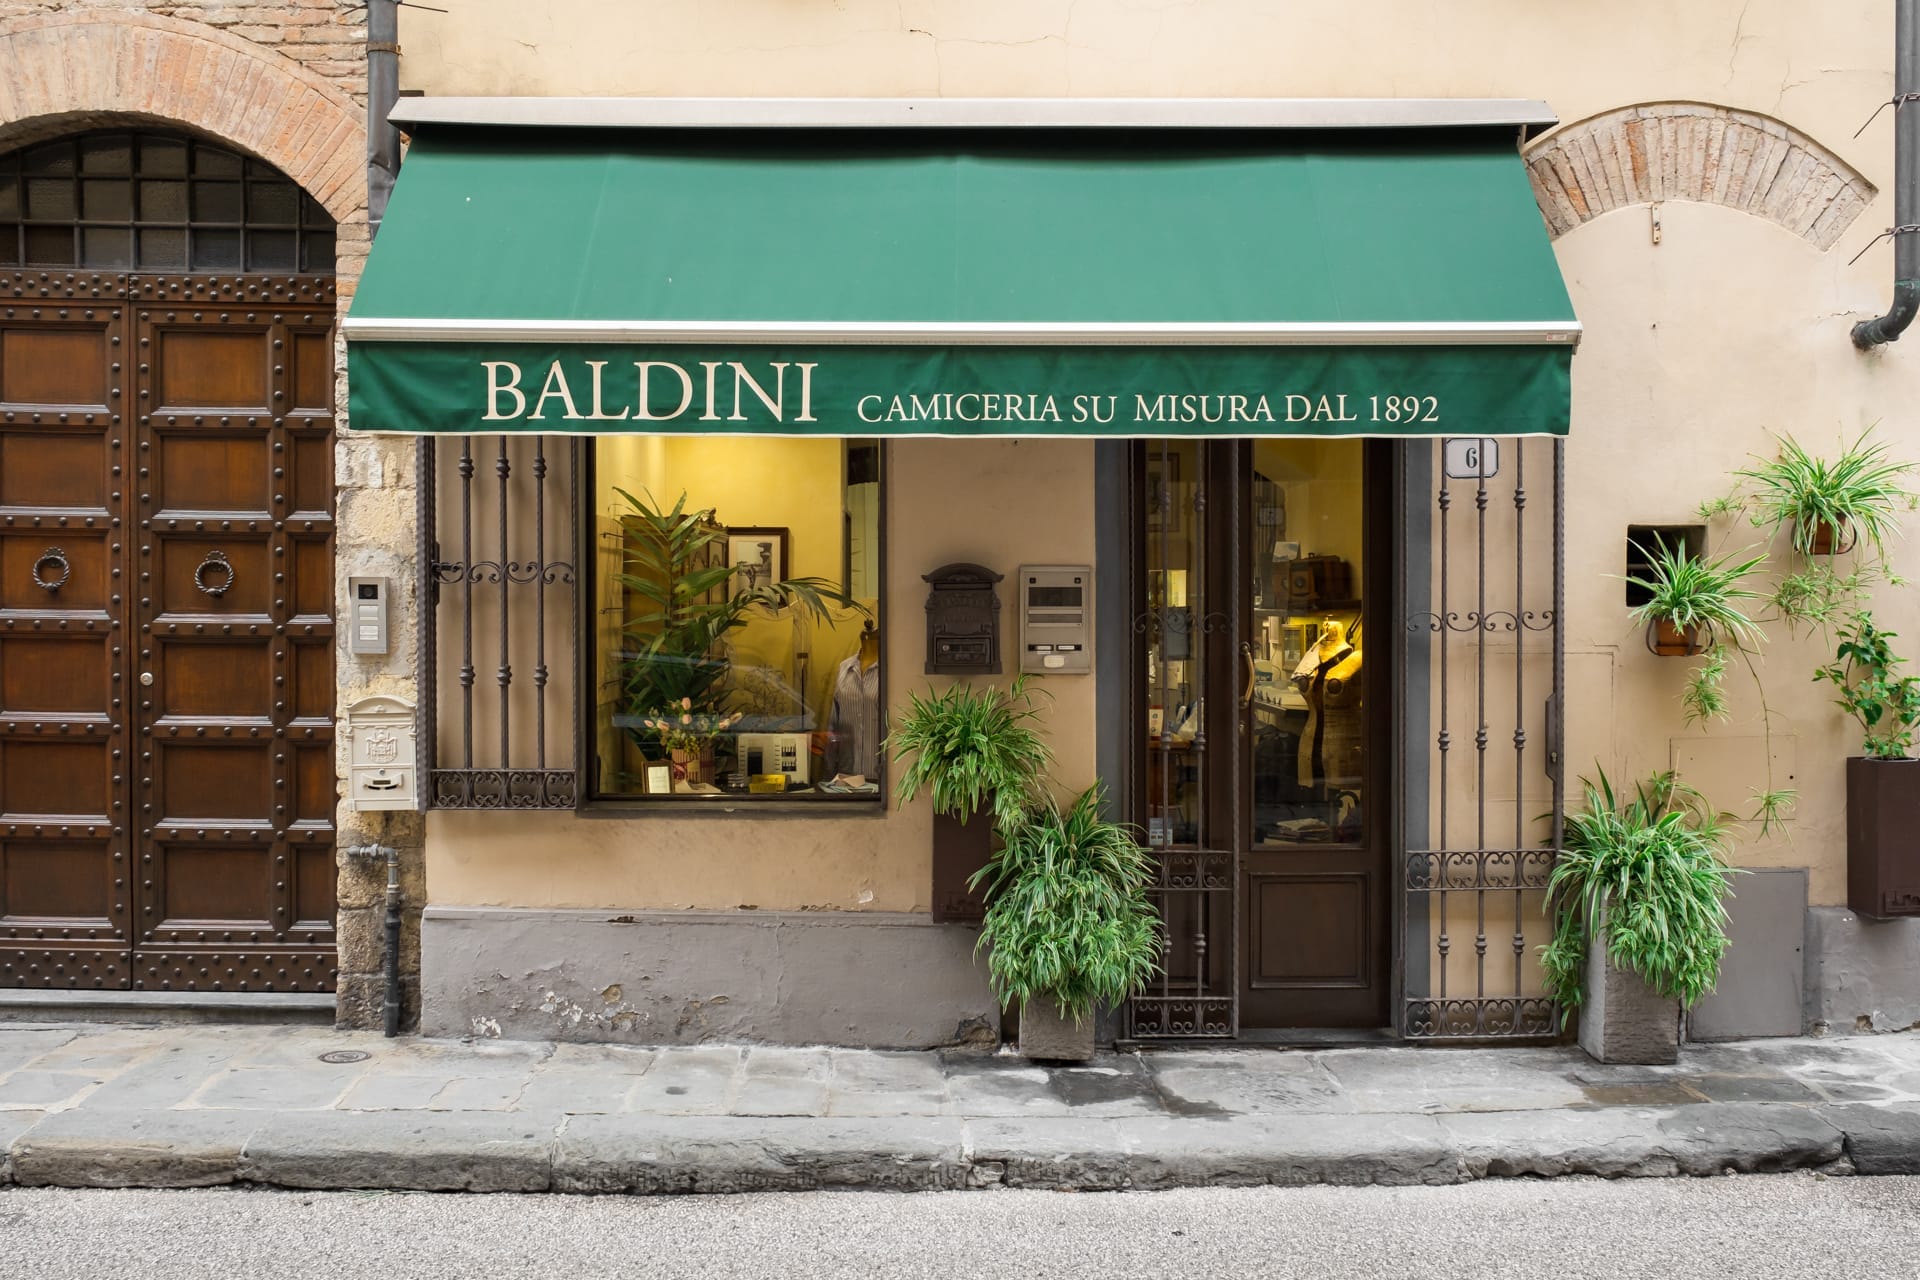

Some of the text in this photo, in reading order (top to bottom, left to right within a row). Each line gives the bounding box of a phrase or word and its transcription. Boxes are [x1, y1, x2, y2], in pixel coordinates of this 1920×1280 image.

[480, 359, 1439, 424] BALDINI CAMICERIA SU MISURA DAL 1892
[1465, 447, 1478, 469] 6
